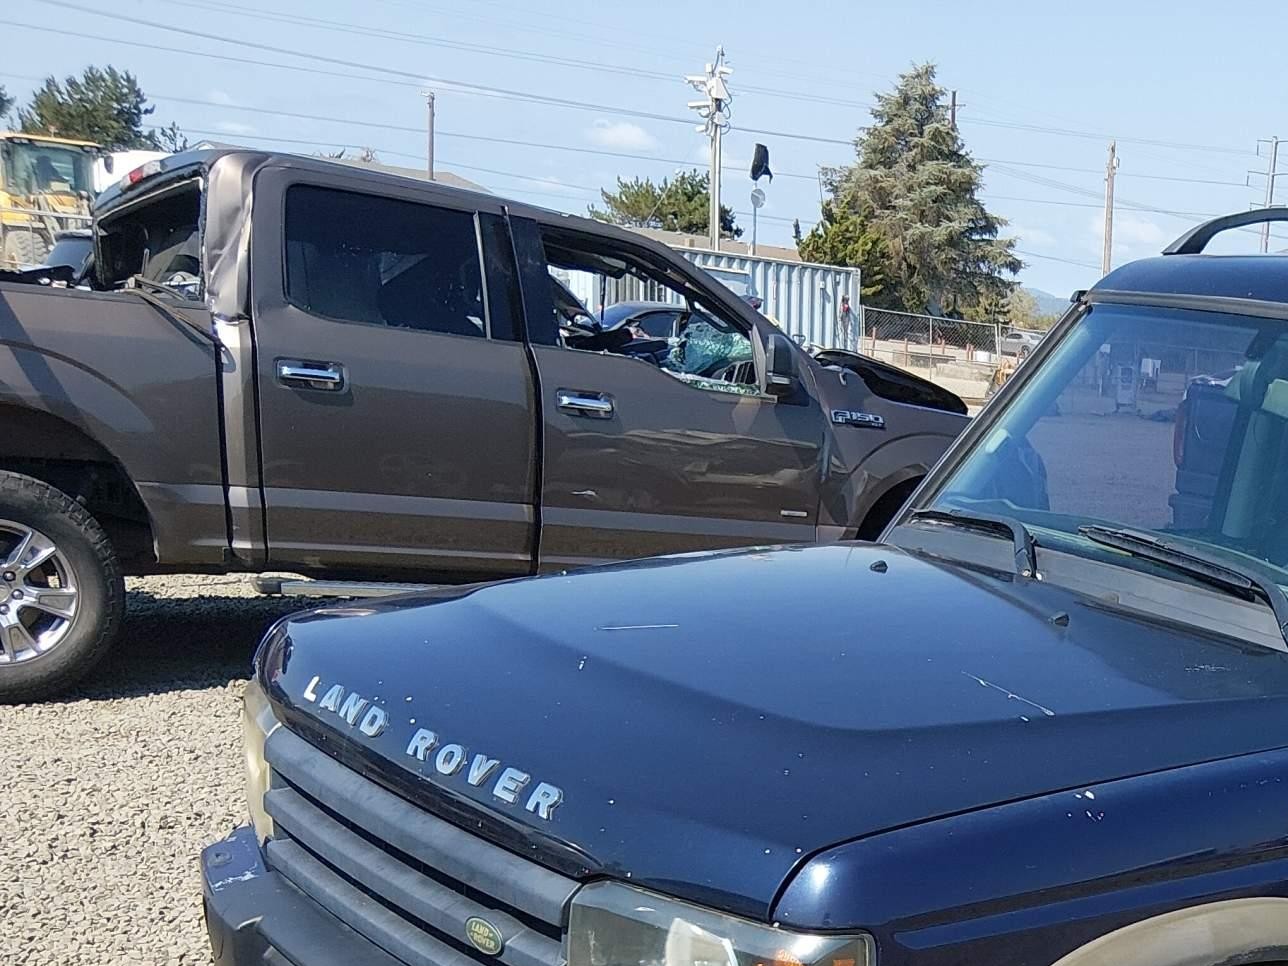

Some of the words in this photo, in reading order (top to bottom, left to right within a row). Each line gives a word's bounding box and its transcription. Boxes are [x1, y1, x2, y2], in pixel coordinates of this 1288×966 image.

[303, 675, 389, 738] LAND
[406, 728, 564, 821] ROVER
[471, 921, 489, 937] LAND
